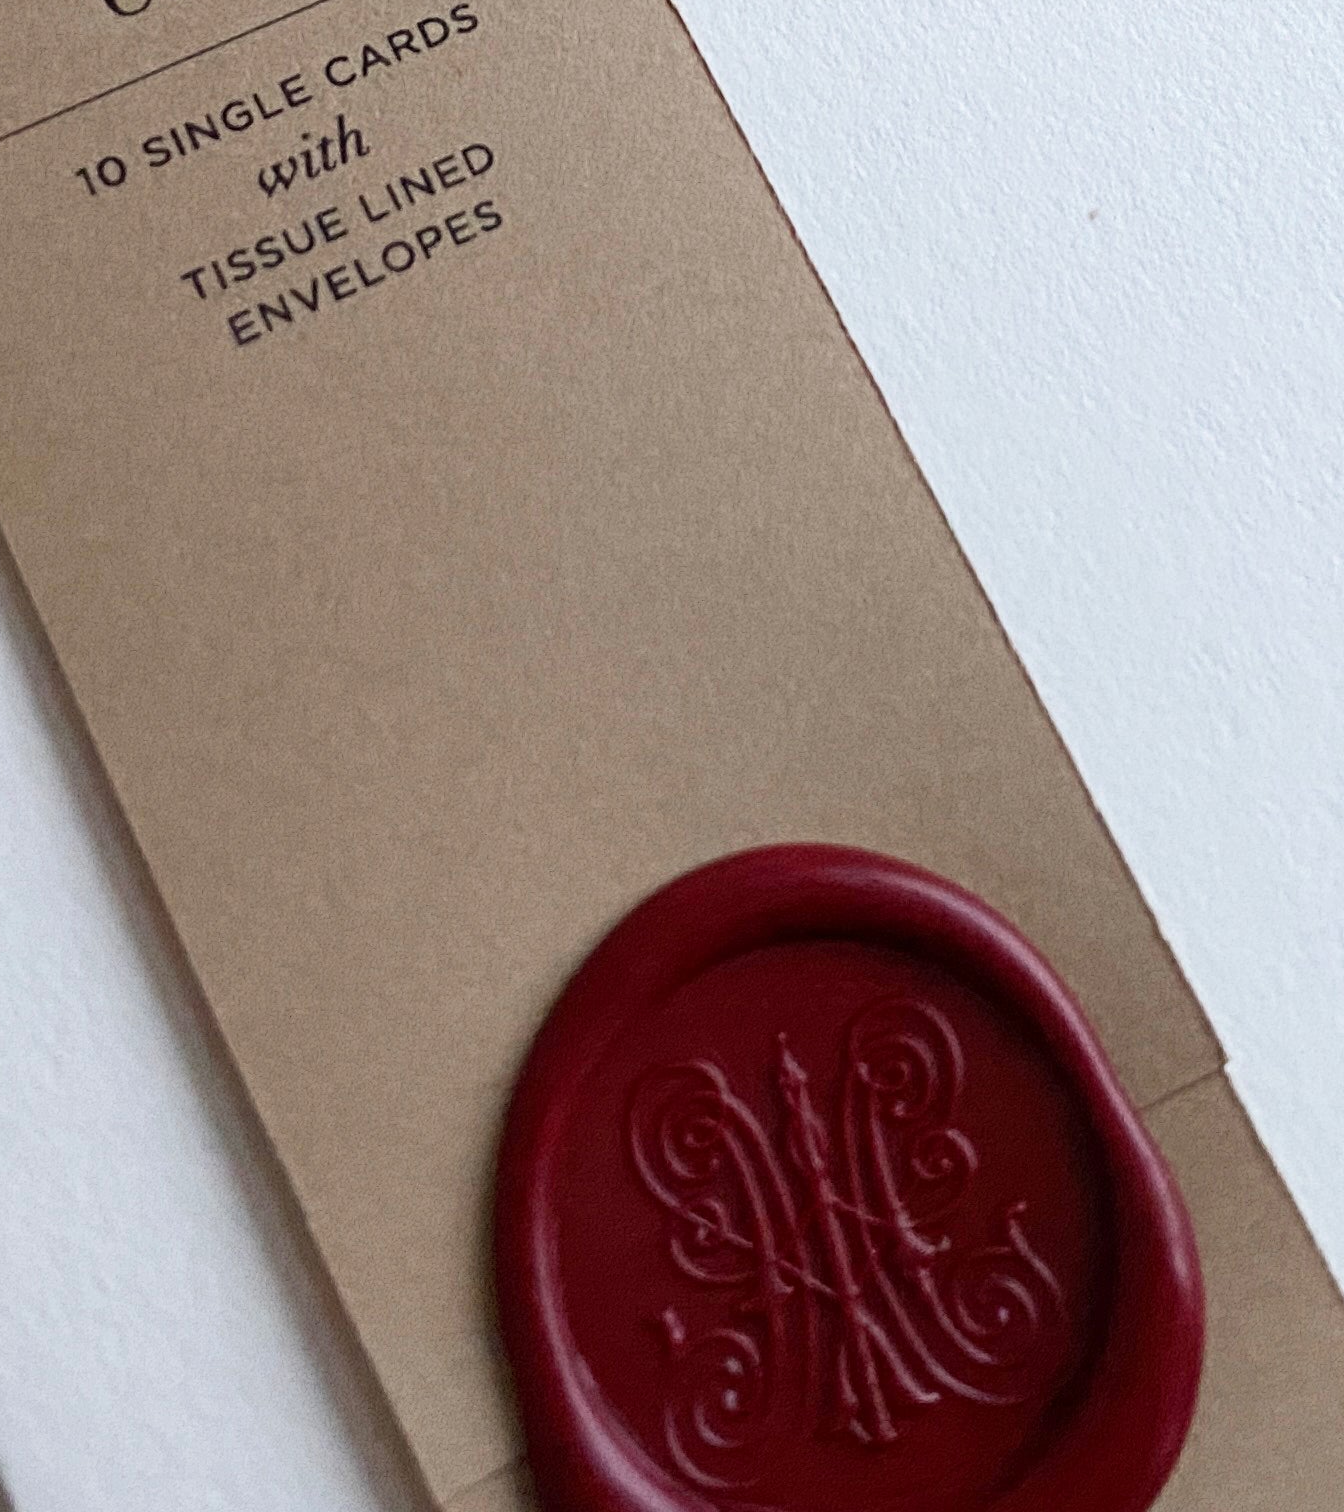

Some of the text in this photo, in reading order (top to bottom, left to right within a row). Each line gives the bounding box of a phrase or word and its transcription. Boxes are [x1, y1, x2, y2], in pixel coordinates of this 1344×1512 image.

[74, 2, 480, 197] 10 SINGLE CARDS
[257, 113, 371, 199] with
[179, 143, 495, 301] TISSUE LINED
[227, 199, 504, 347] ENVELOPES
